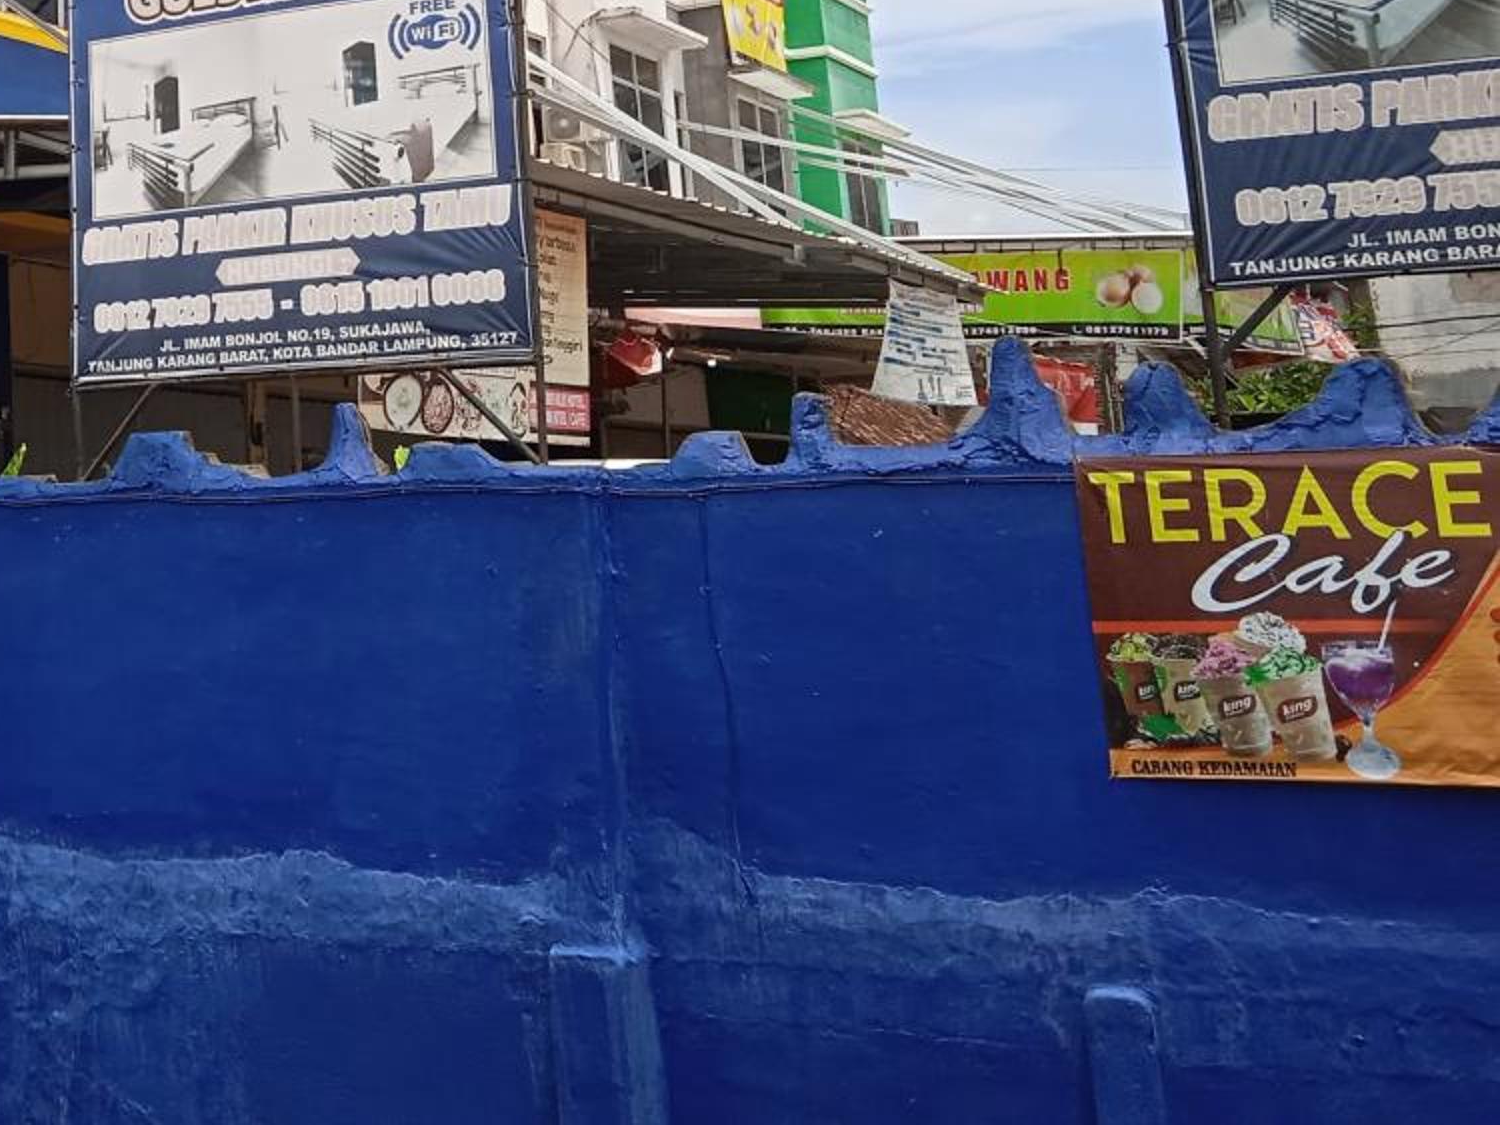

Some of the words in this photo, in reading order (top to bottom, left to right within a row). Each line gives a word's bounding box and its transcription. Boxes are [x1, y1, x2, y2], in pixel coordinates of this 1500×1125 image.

[1348, 232, 1380, 248] JL.
[1387, 226, 1446, 246] IMAM
[1230, 255, 1336, 275] TANJUNG
[1344, 248, 1439, 268] KARANG
[88, 358, 153, 373] TANJUNG
[157, 352, 215, 369] KARANG
[220, 348, 269, 365] BARAT,
[273, 344, 312, 360] KOTA
[317, 340, 379, 357] BANDAR
[383, 333, 466, 353] LAMPUNG,
[471, 331, 517, 346] 35127
[160, 339, 180, 352] JL.
[184, 335, 221, 350] IMAM
[225, 329, 283, 348] BONJOL
[1088, 460, 1492, 544] TERACE
[1191, 527, 1455, 614] Cafe
[1223, 696, 1252, 713] king
[1283, 697, 1313, 716] king
[1132, 760, 1193, 775] CABANG
[1198, 761, 1298, 777] KEDAMAIAN
